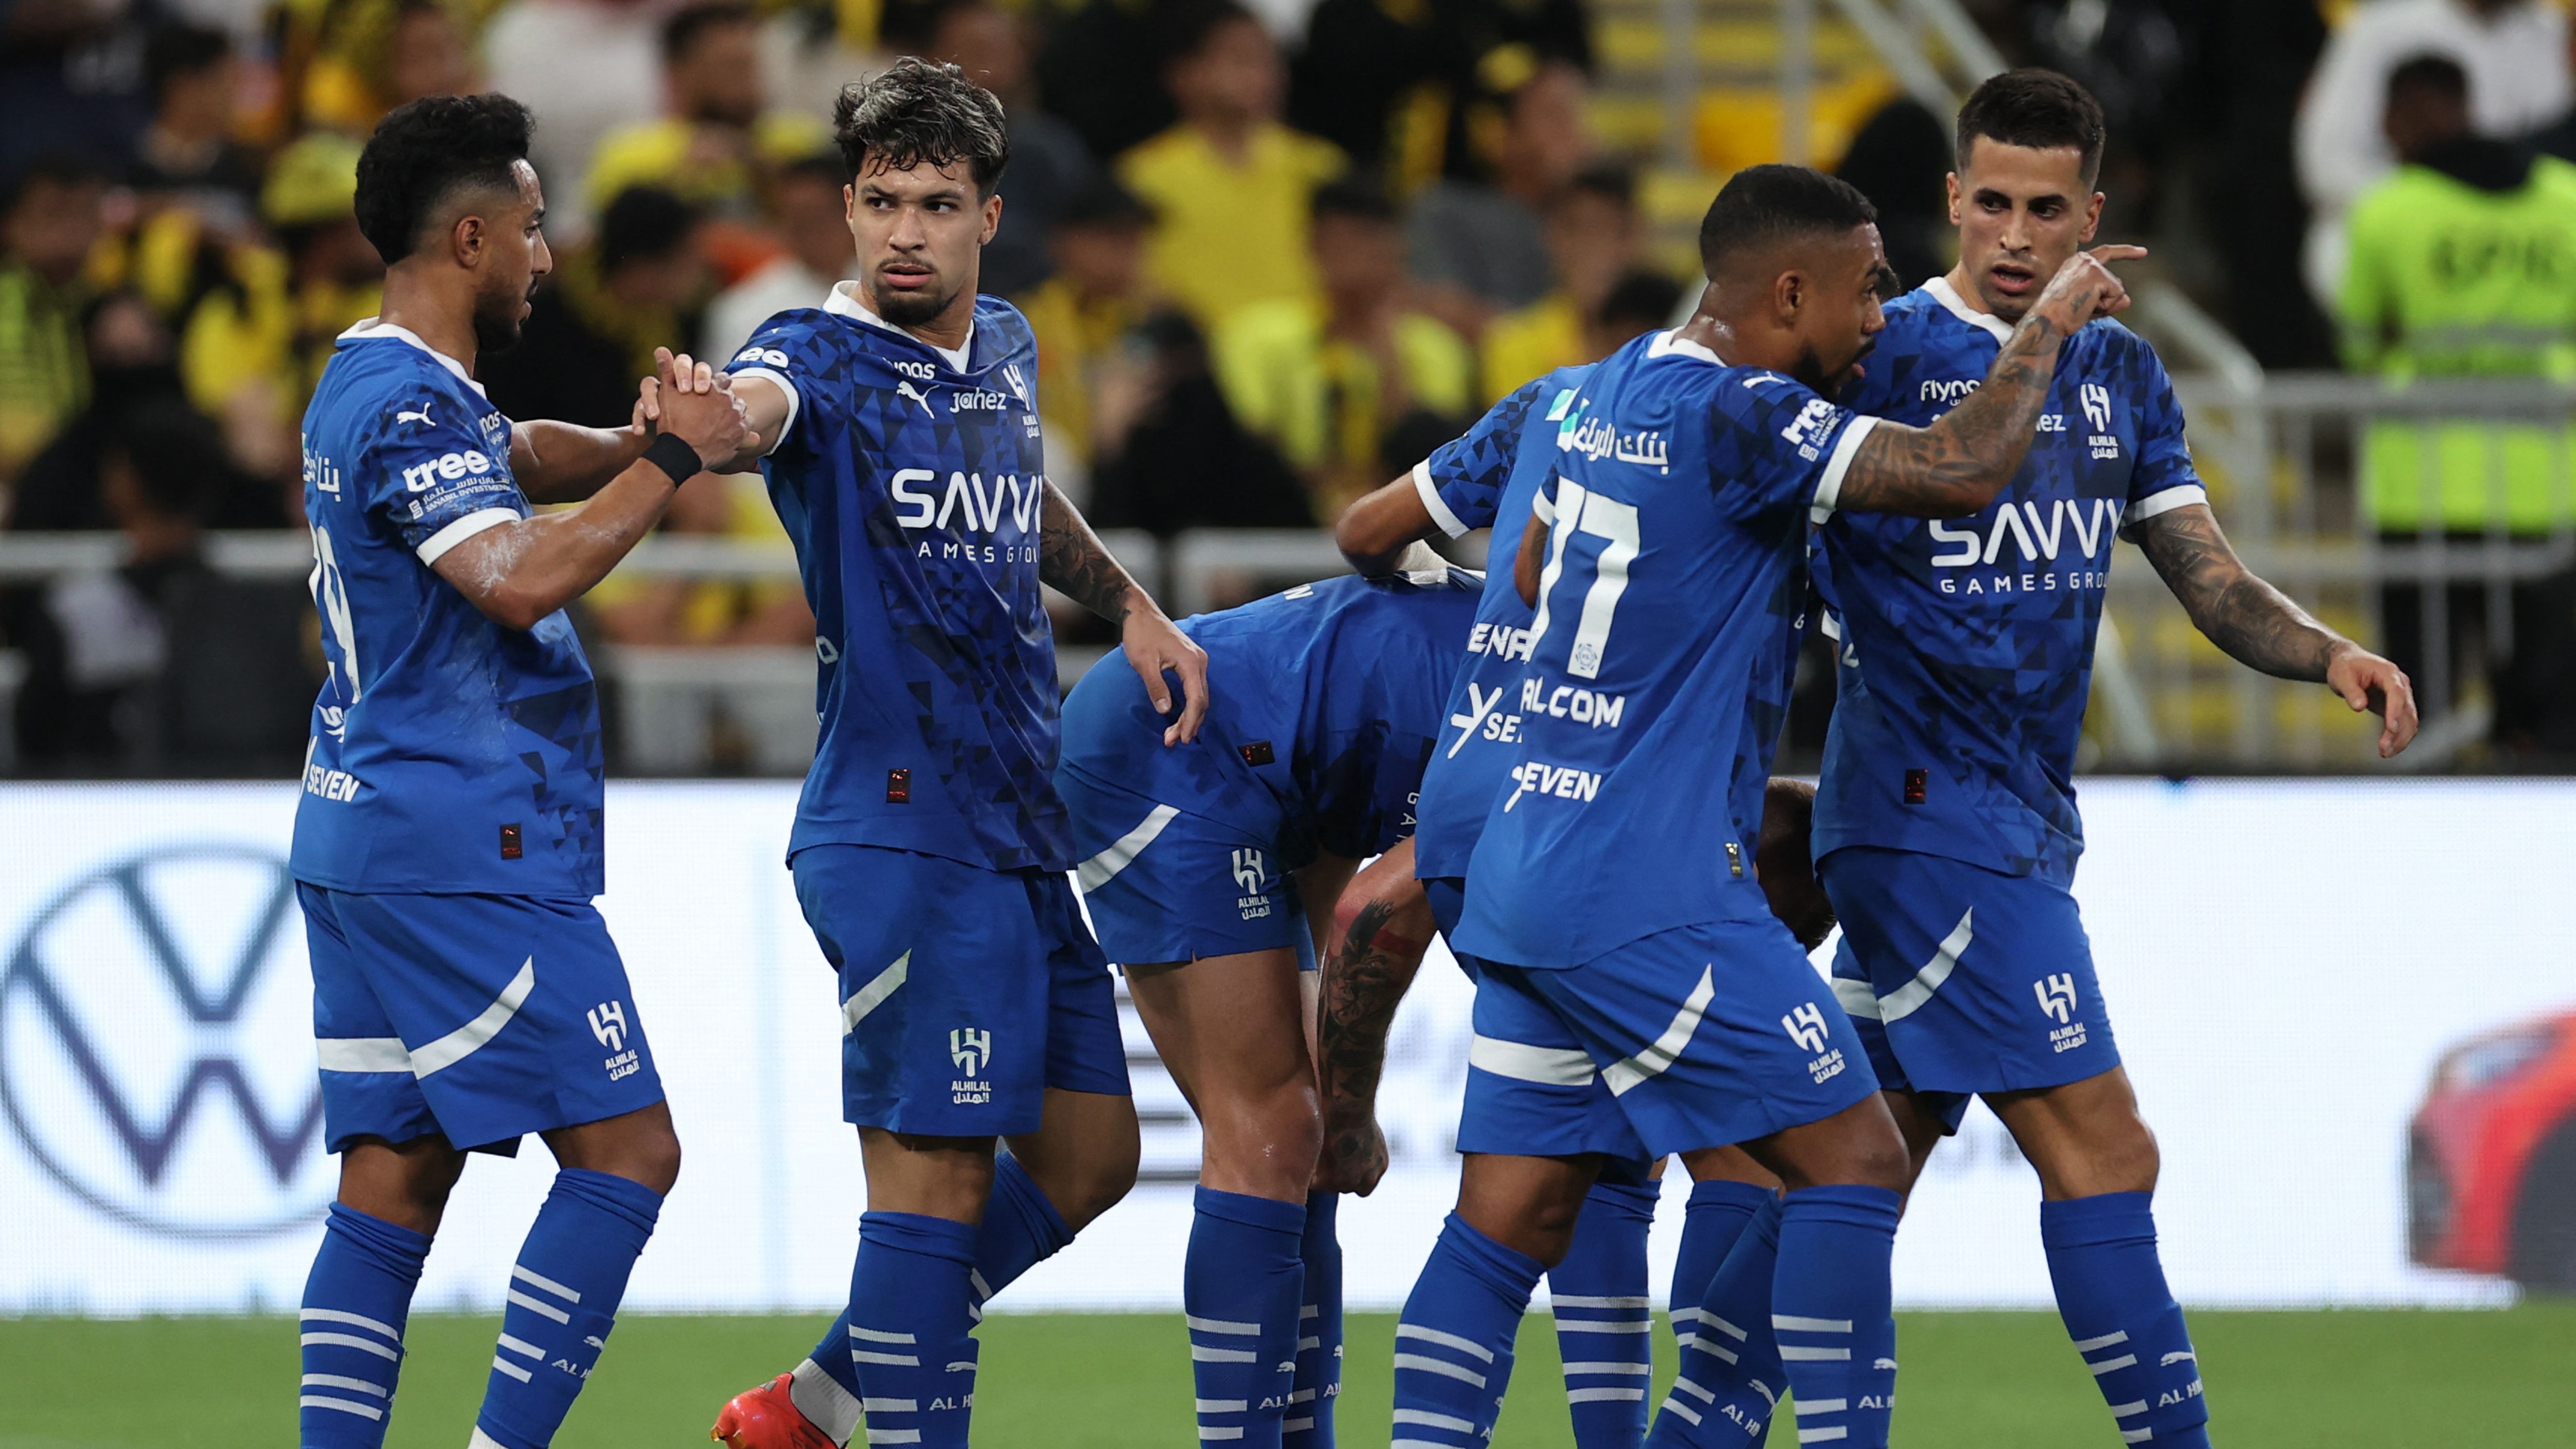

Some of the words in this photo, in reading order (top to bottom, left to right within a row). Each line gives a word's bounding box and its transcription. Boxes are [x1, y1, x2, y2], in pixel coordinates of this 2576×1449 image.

[735, 347, 789, 368] ee
[949, 387, 1006, 413] jahez
[1781, 399, 1835, 445] tre
[2035, 414, 2066, 432] ez
[2088, 435, 2118, 447] ALHILAL
[402, 450, 490, 492] tree
[918, 542, 995, 563] AMES
[1940, 572, 2057, 595] GAMES
[308, 520, 362, 704] 9
[1520, 676, 1625, 729] ALCOM
[307, 763, 360, 802] SEVEN
[1521, 761, 1602, 802] EVEN
[1238, 895, 1269, 909] ALHILAL
[1241, 905, 1271, 920] الهلال
[2049, 1022, 2086, 1042] ALHILAL
[605, 1049, 638, 1071] ALHILAL
[951, 1080, 991, 1092] ALHILAL
[953, 1092, 990, 1105] الهلال
[929, 1397, 957, 1411] AL
[1858, 1395, 1885, 1409] AL
[2158, 1389, 2185, 1407] AL
[1720, 1404, 1744, 1425] AL
